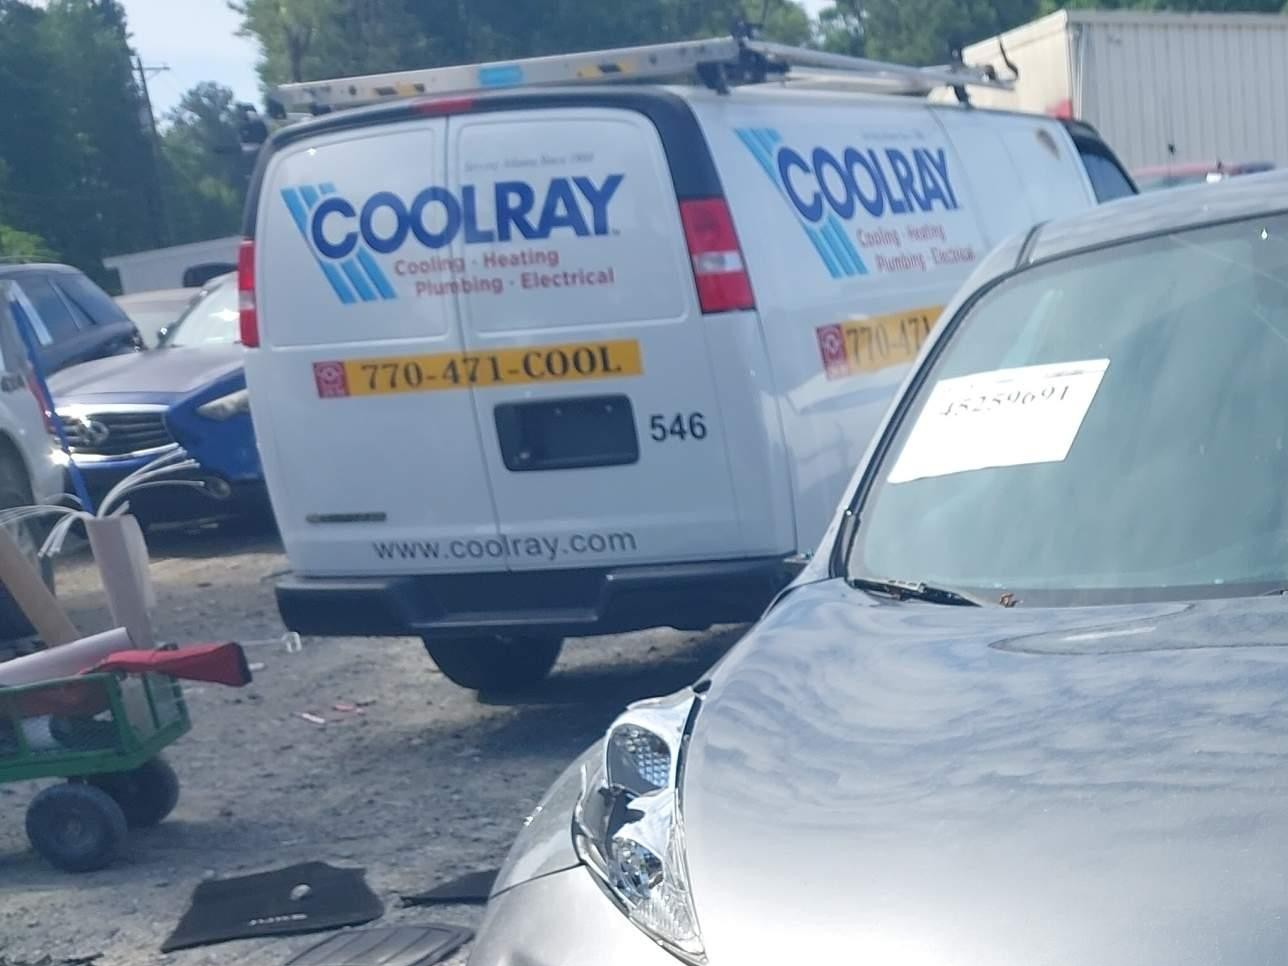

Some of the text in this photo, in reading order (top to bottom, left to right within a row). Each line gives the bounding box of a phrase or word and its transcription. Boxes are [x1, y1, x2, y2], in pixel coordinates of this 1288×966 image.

[777, 147, 959, 222] COOLRAY
[312, 174, 625, 259] COOLRAY
[394, 249, 560, 277] Cooling Heating
[415, 267, 615, 297] Plumbing Electrical
[361, 345, 622, 389] 770-471-COOL
[650, 411, 708, 442] 546
[372, 530, 637, 561] www.coolray.com
